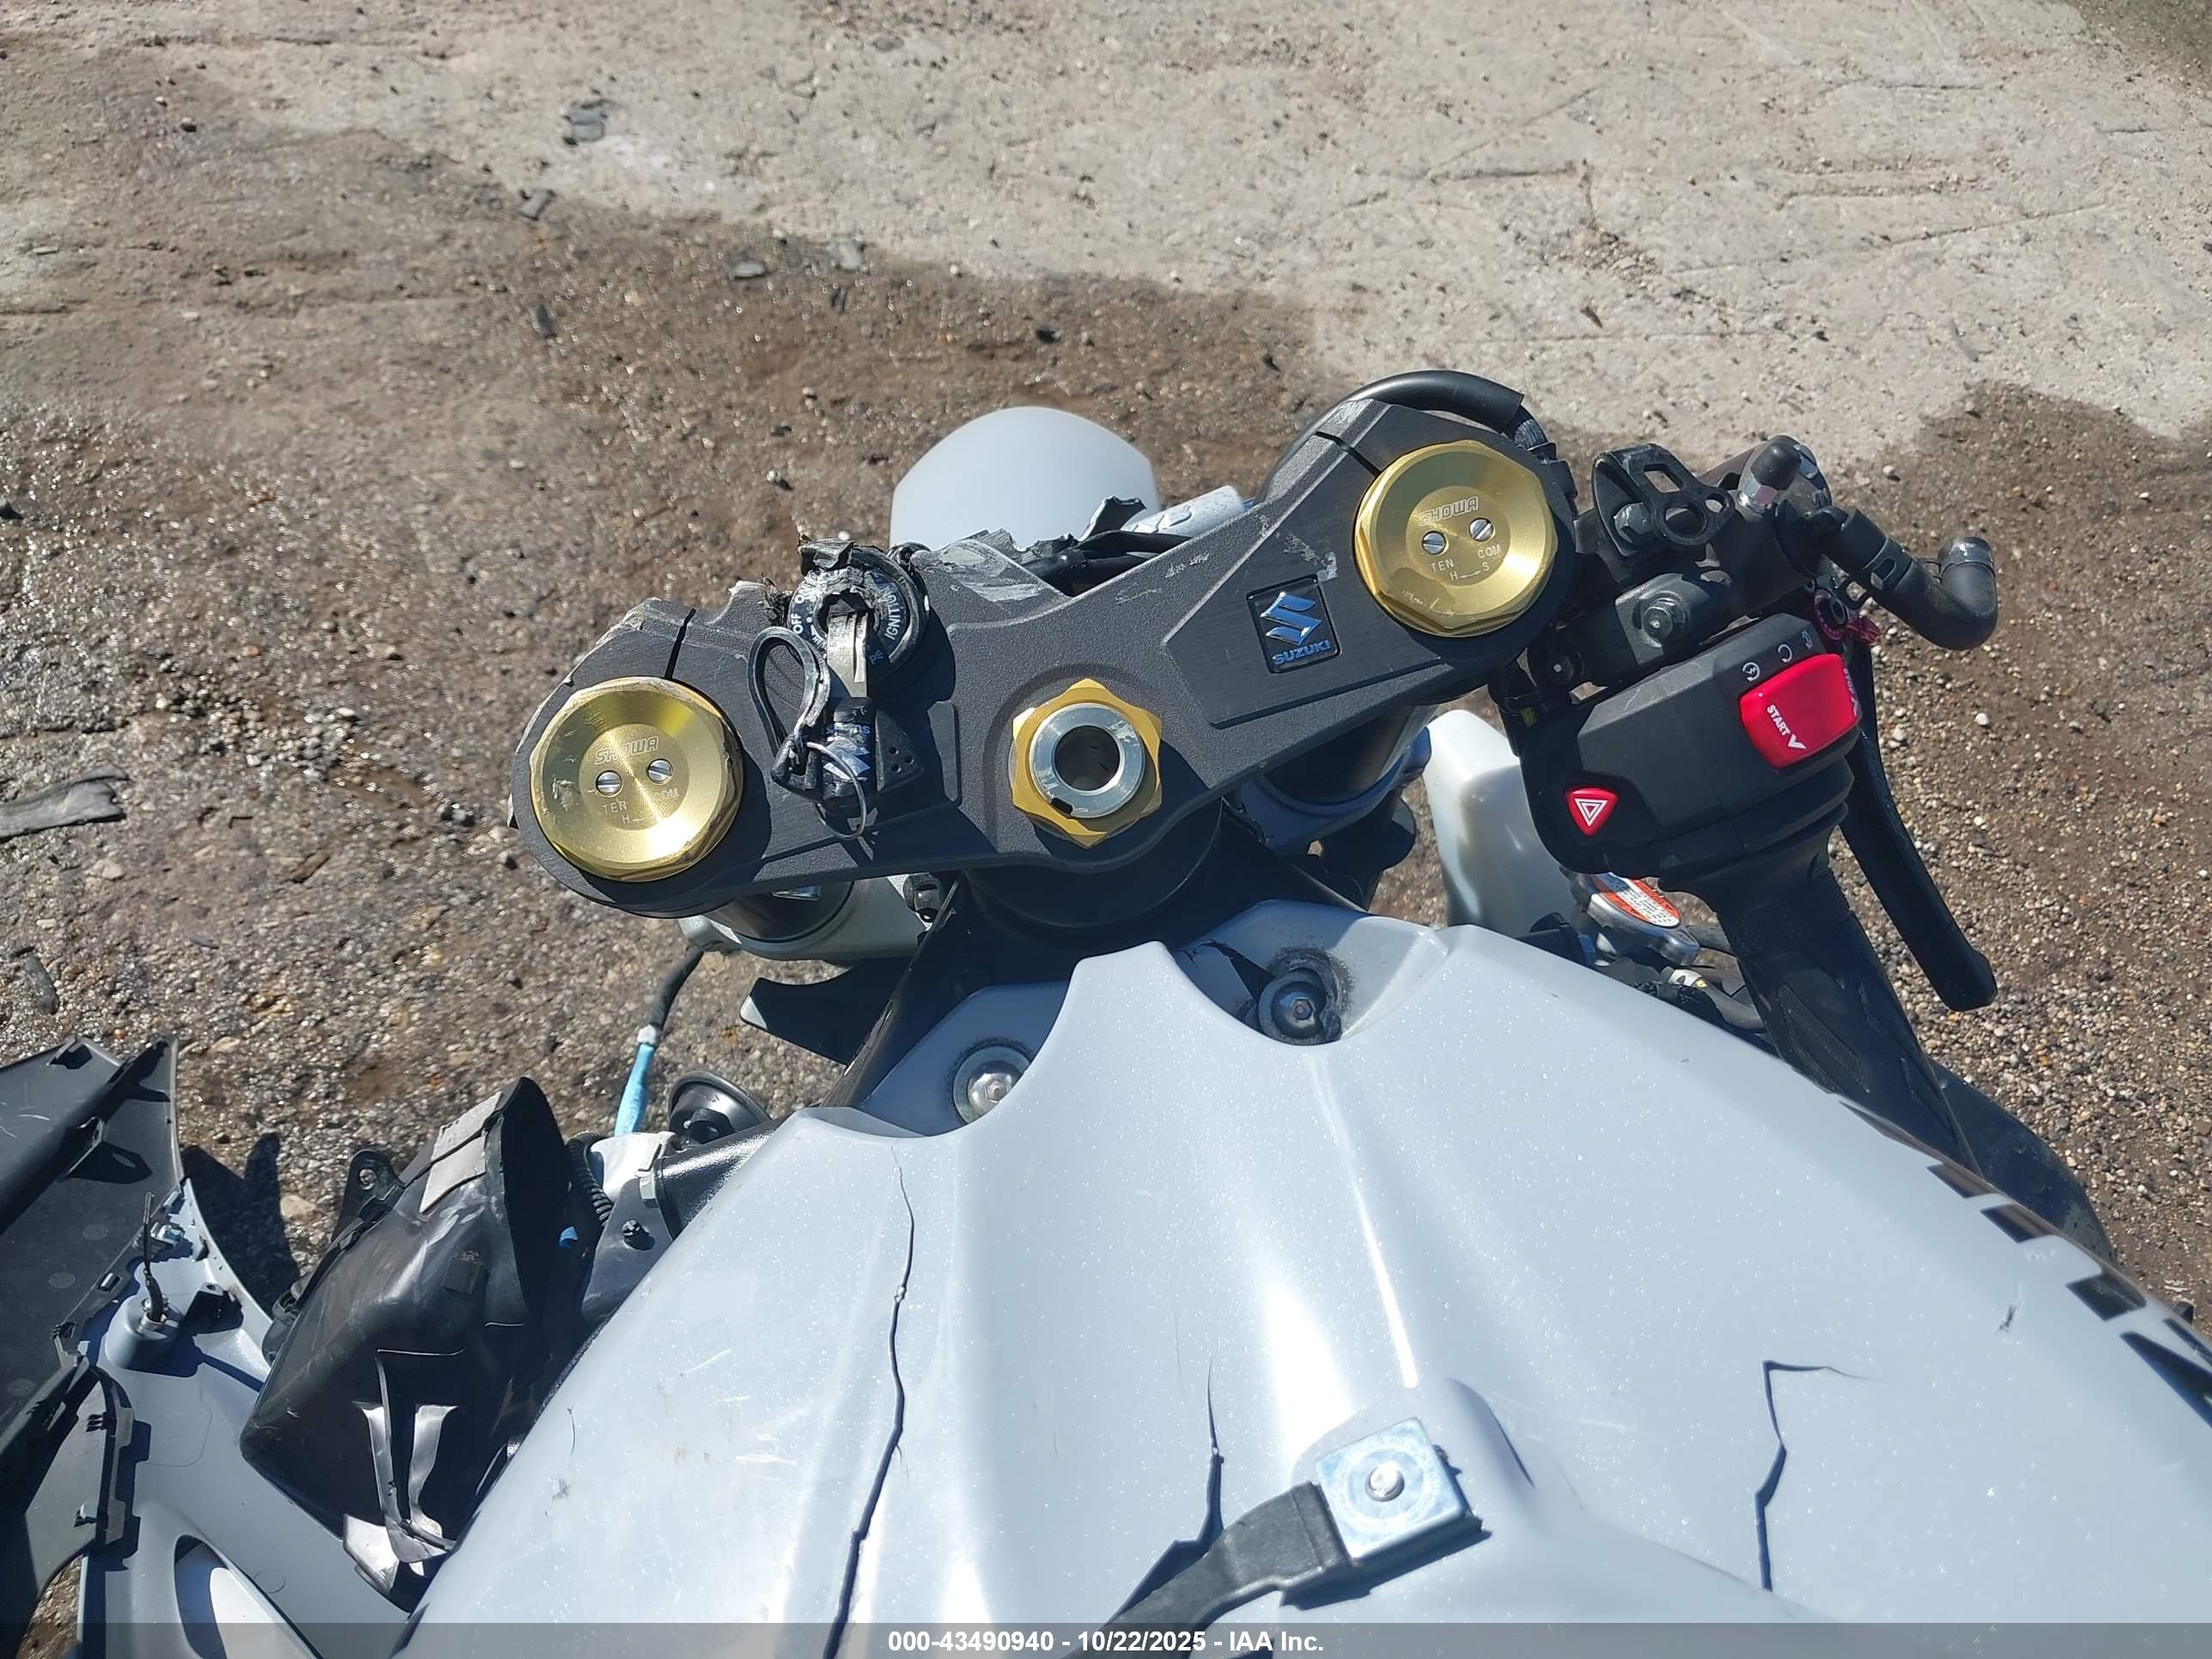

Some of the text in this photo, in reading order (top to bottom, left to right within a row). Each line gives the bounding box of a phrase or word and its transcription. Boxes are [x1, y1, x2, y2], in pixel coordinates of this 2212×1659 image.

[1419, 496, 1479, 525] SHOWA
[1431, 544, 1502, 573] TEN COM
[791, 613, 804, 635] OFF
[1273, 639, 1330, 665] SUZUKI
[1766, 704, 1790, 736] START
[602, 800, 627, 816] TEN
